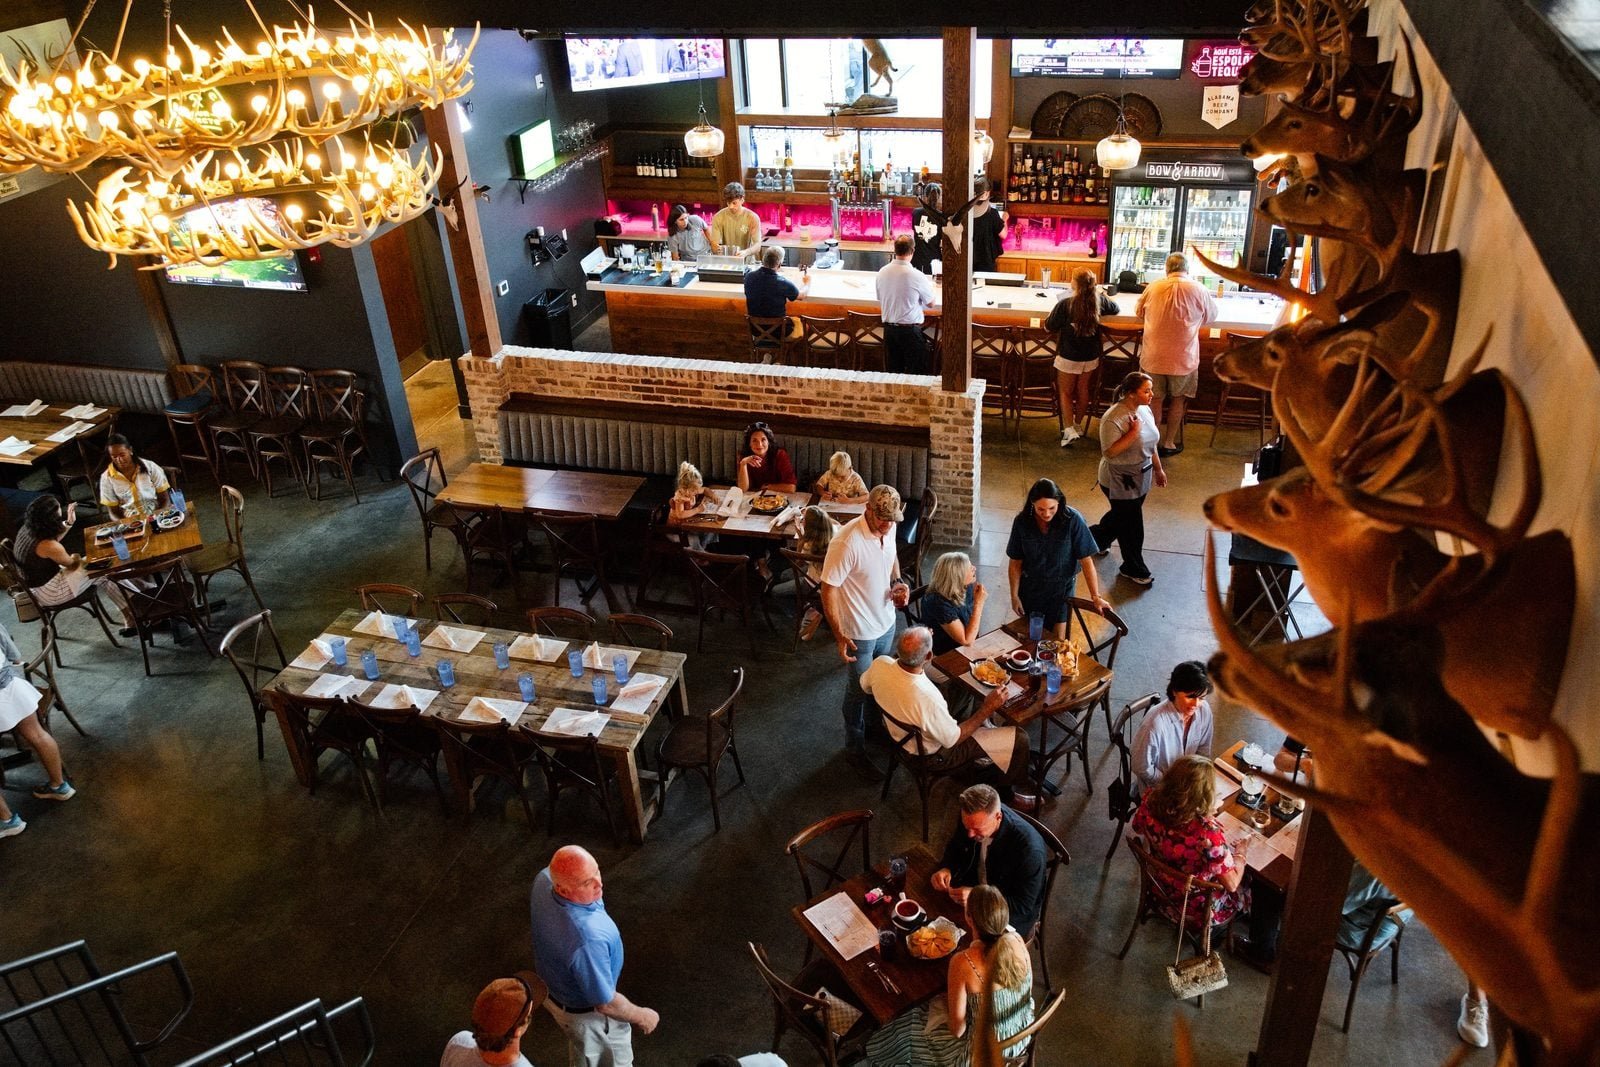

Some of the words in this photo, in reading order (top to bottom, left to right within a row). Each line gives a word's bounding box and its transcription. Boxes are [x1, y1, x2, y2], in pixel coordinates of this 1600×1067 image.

[1212, 66, 1240, 77] TEQU
[1149, 165, 1172, 176] BOW
[1172, 161, 1183, 181] &
[1183, 166, 1222, 178] ARROW
